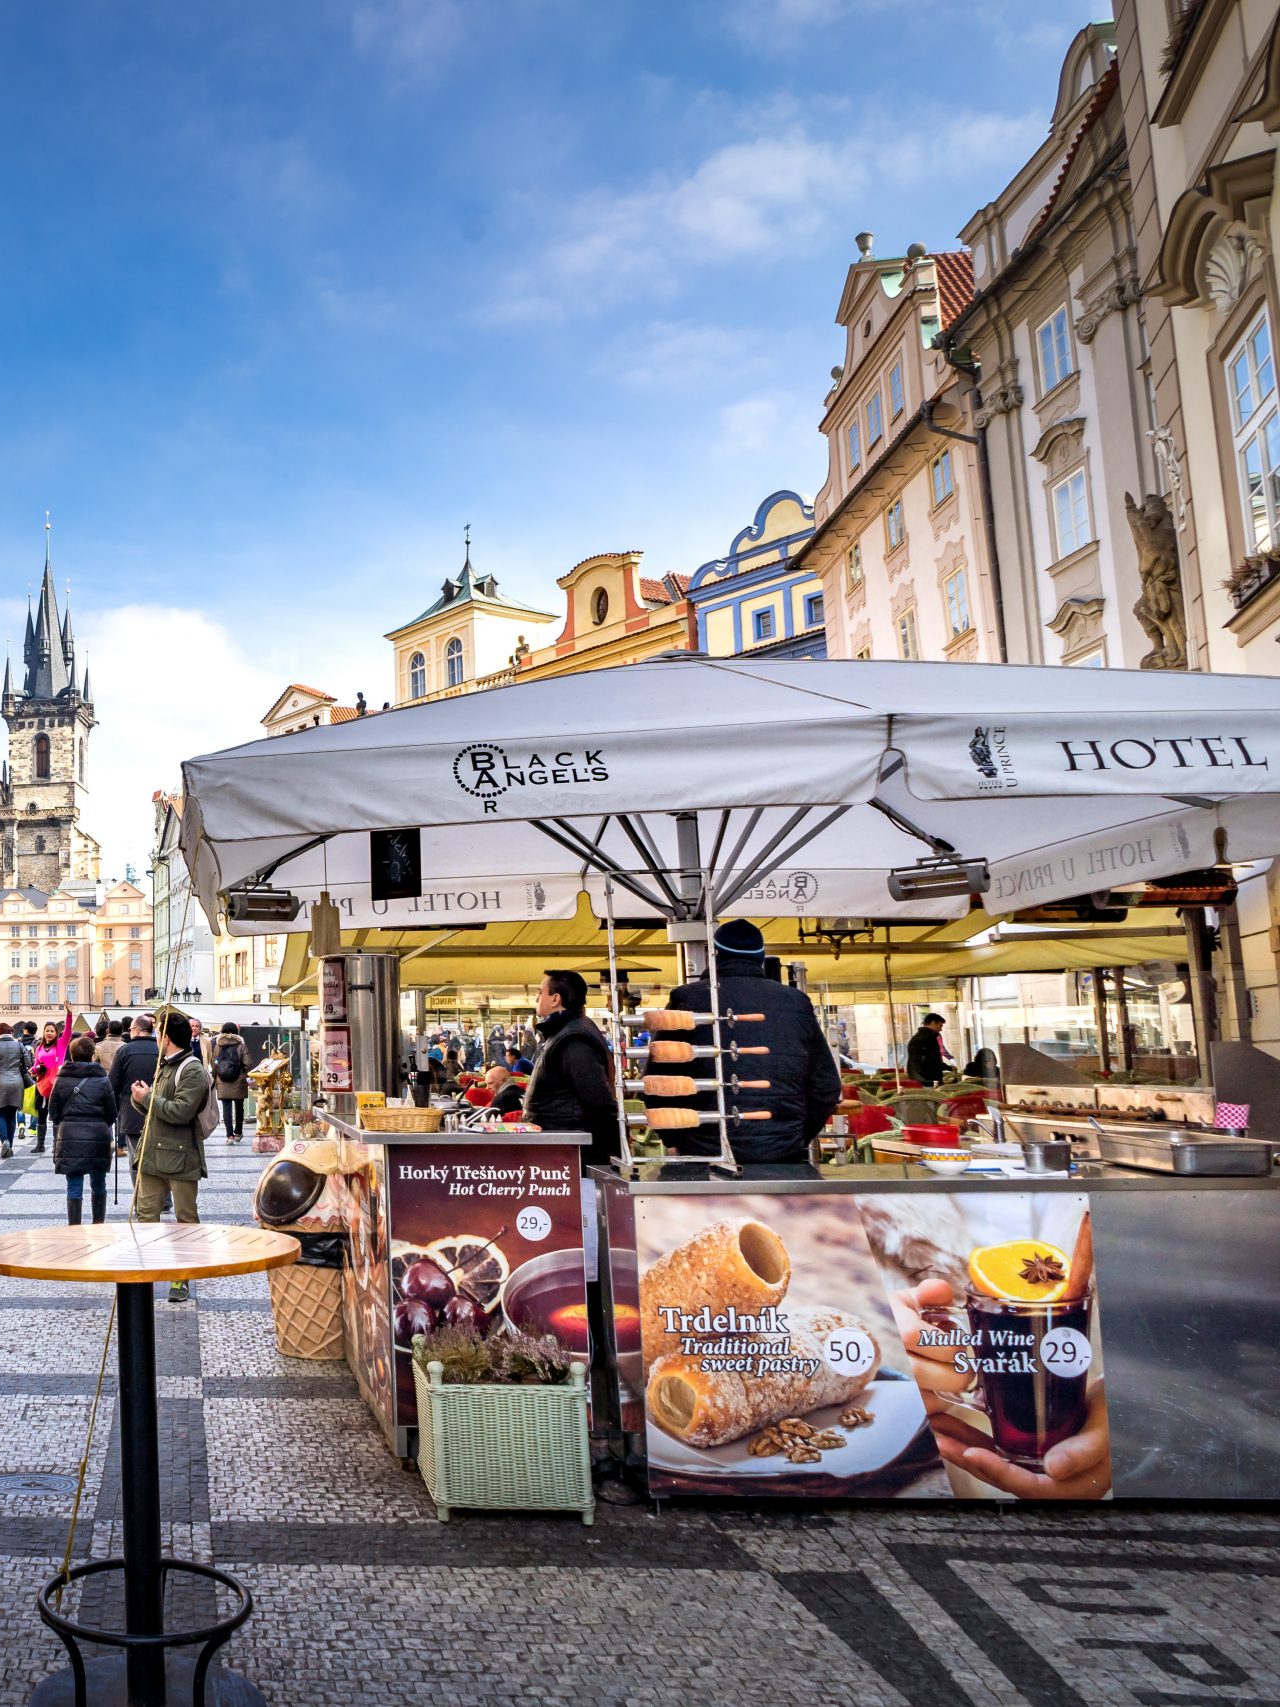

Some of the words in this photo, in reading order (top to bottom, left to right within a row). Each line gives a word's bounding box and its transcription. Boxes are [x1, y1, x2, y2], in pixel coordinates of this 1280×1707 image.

[470, 750, 606, 771] BLACK
[993, 726, 1015, 774] PRINCE
[1056, 735, 1269, 772] HOTEL
[474, 767, 610, 790] ANGEL'S
[1006, 778, 1019, 788] U
[483, 801, 498, 813] R
[399, 1165, 449, 1183] Horký
[452, 1165, 526, 1184] Třešňový
[529, 1165, 571, 1181] Punč
[448, 1183, 474, 1196] Hot
[478, 1183, 525, 1199] Cherry
[528, 1183, 571, 1196] Punch
[520, 1216, 548, 1232] 29,-
[658, 1305, 790, 1334] Trdelník
[681, 1337, 791, 1356] Traditional
[918, 1329, 983, 1346] Mulled
[988, 1329, 1036, 1346] Wine
[830, 1341, 873, 1366] 50,-
[953, 1350, 1039, 1374] Svařák
[1045, 1341, 1090, 1365] 29,-
[701, 1356, 754, 1373] sweet
[756, 1356, 820, 1378] pastry
